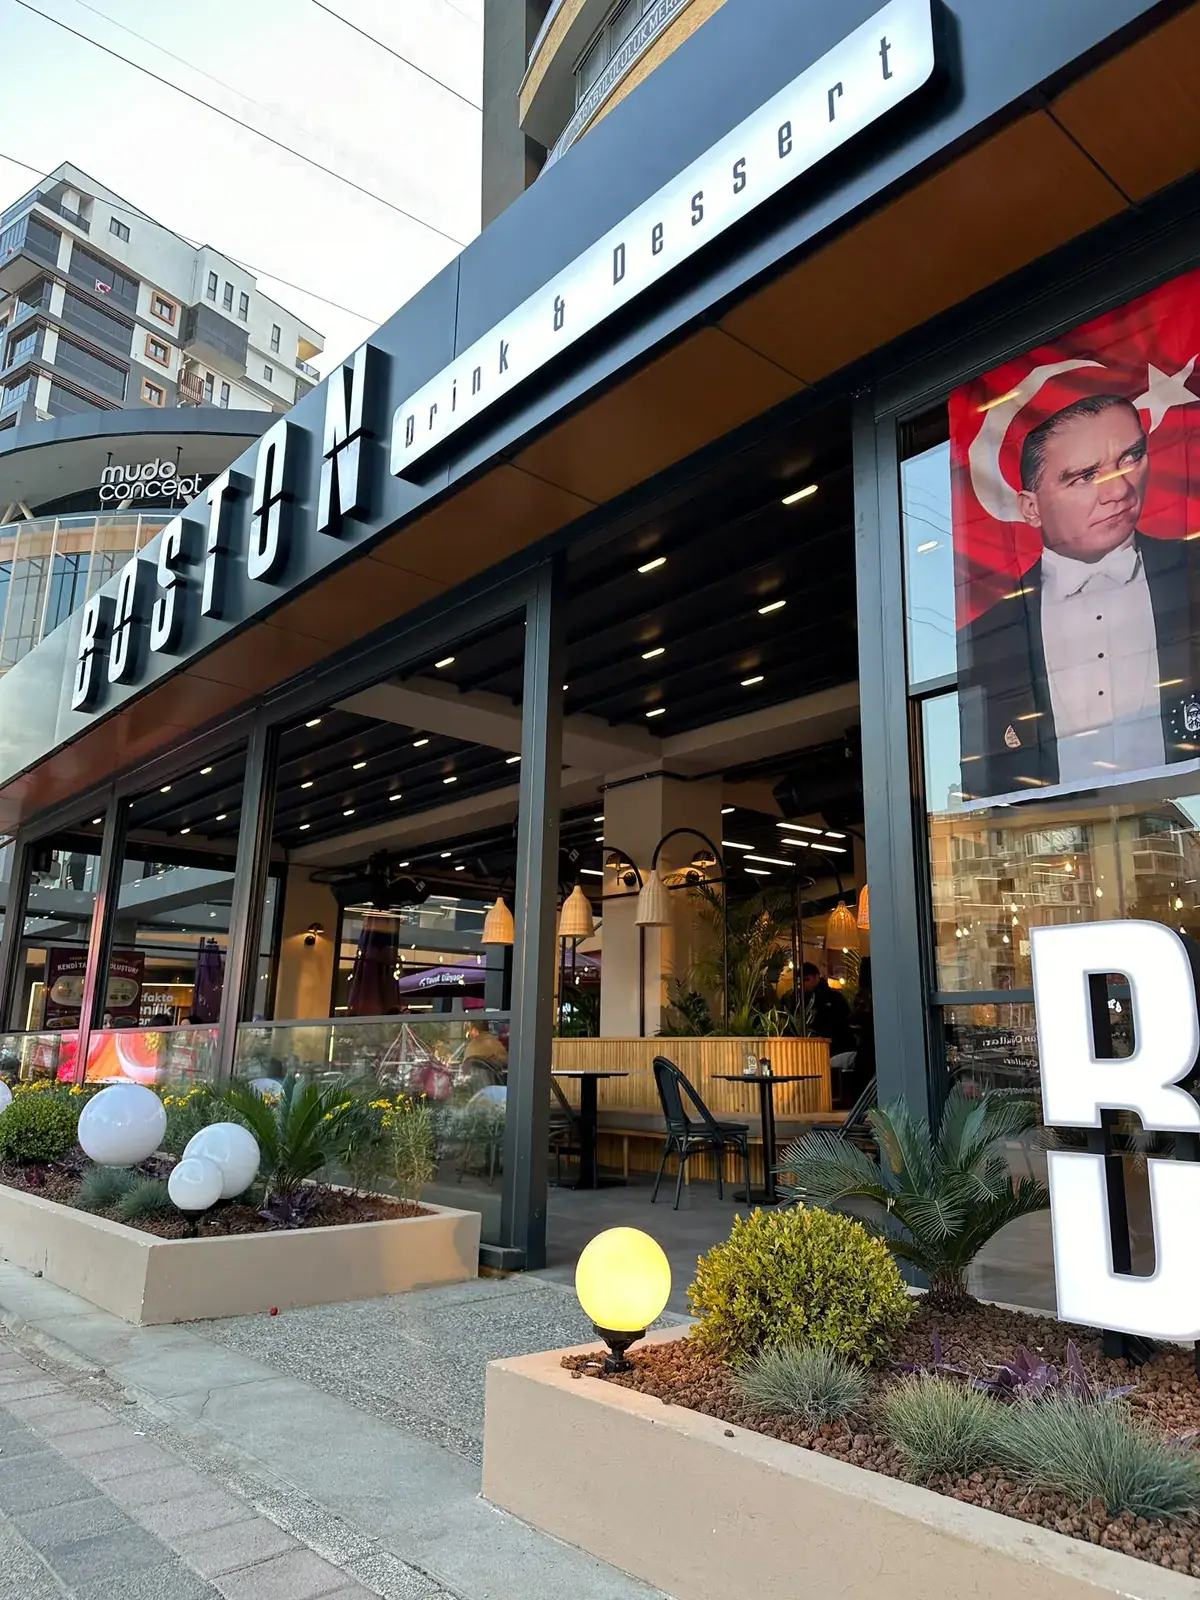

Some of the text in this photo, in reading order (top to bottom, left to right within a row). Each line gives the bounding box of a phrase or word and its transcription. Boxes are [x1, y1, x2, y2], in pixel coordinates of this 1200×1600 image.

[649, 0, 678, 33] MER
[405, 36, 893, 449] Drink & Dessert
[99, 473, 202, 500] concept
[100, 458, 177, 484] mudo
[71, 342, 372, 713] BOSTON
